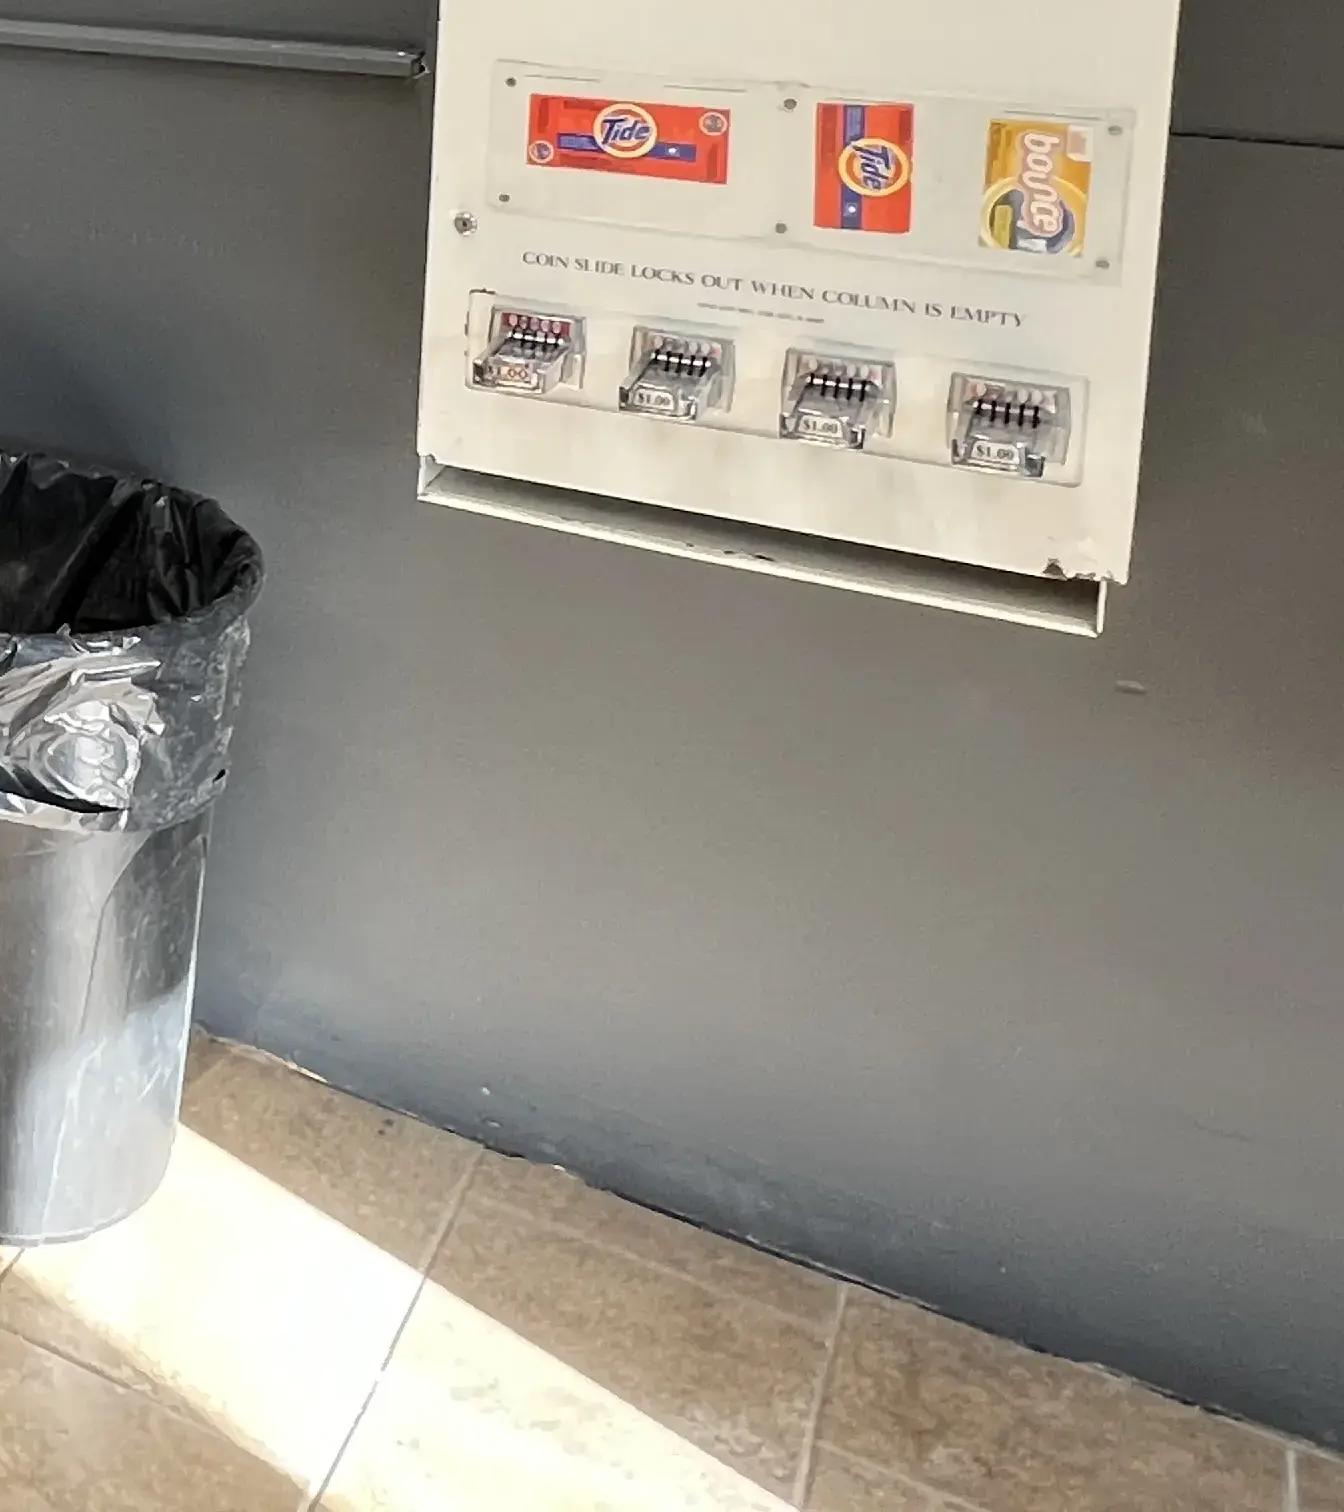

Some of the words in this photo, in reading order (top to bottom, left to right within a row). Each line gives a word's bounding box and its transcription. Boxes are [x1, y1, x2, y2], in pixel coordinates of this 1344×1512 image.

[600, 114, 652, 146] Tide
[853, 142, 892, 191] Tide
[1022, 131, 1063, 235] bounce
[522, 250, 569, 269] COIN
[574, 257, 625, 276] SLIDE
[631, 264, 695, 286] LOCKS
[701, 274, 744, 292] OUT
[751, 279, 815, 300] WHEN
[821, 289, 915, 314] COLUMN
[924, 302, 942, 318] IS
[950, 305, 1027, 328] EMPTY
